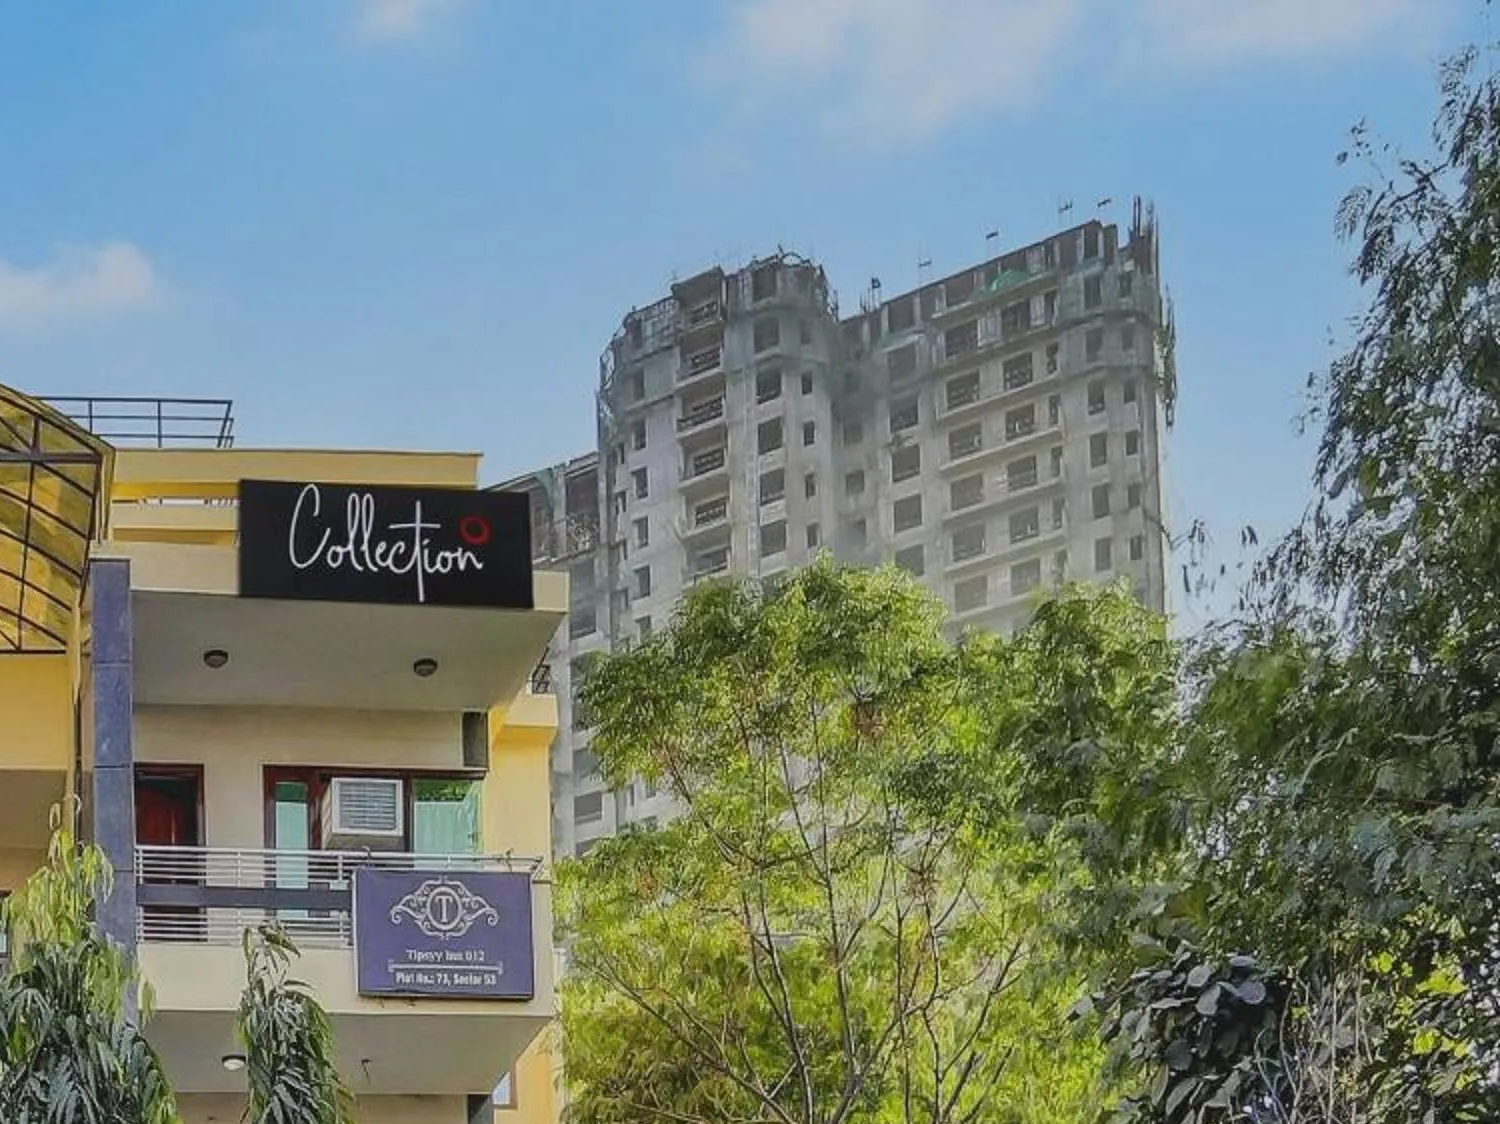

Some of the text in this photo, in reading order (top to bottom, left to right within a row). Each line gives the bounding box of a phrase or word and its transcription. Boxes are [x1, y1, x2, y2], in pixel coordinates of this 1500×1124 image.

[289, 483, 484, 602] Collection
[465, 950, 485, 961] 012
[453, 972, 482, 985] Sector
